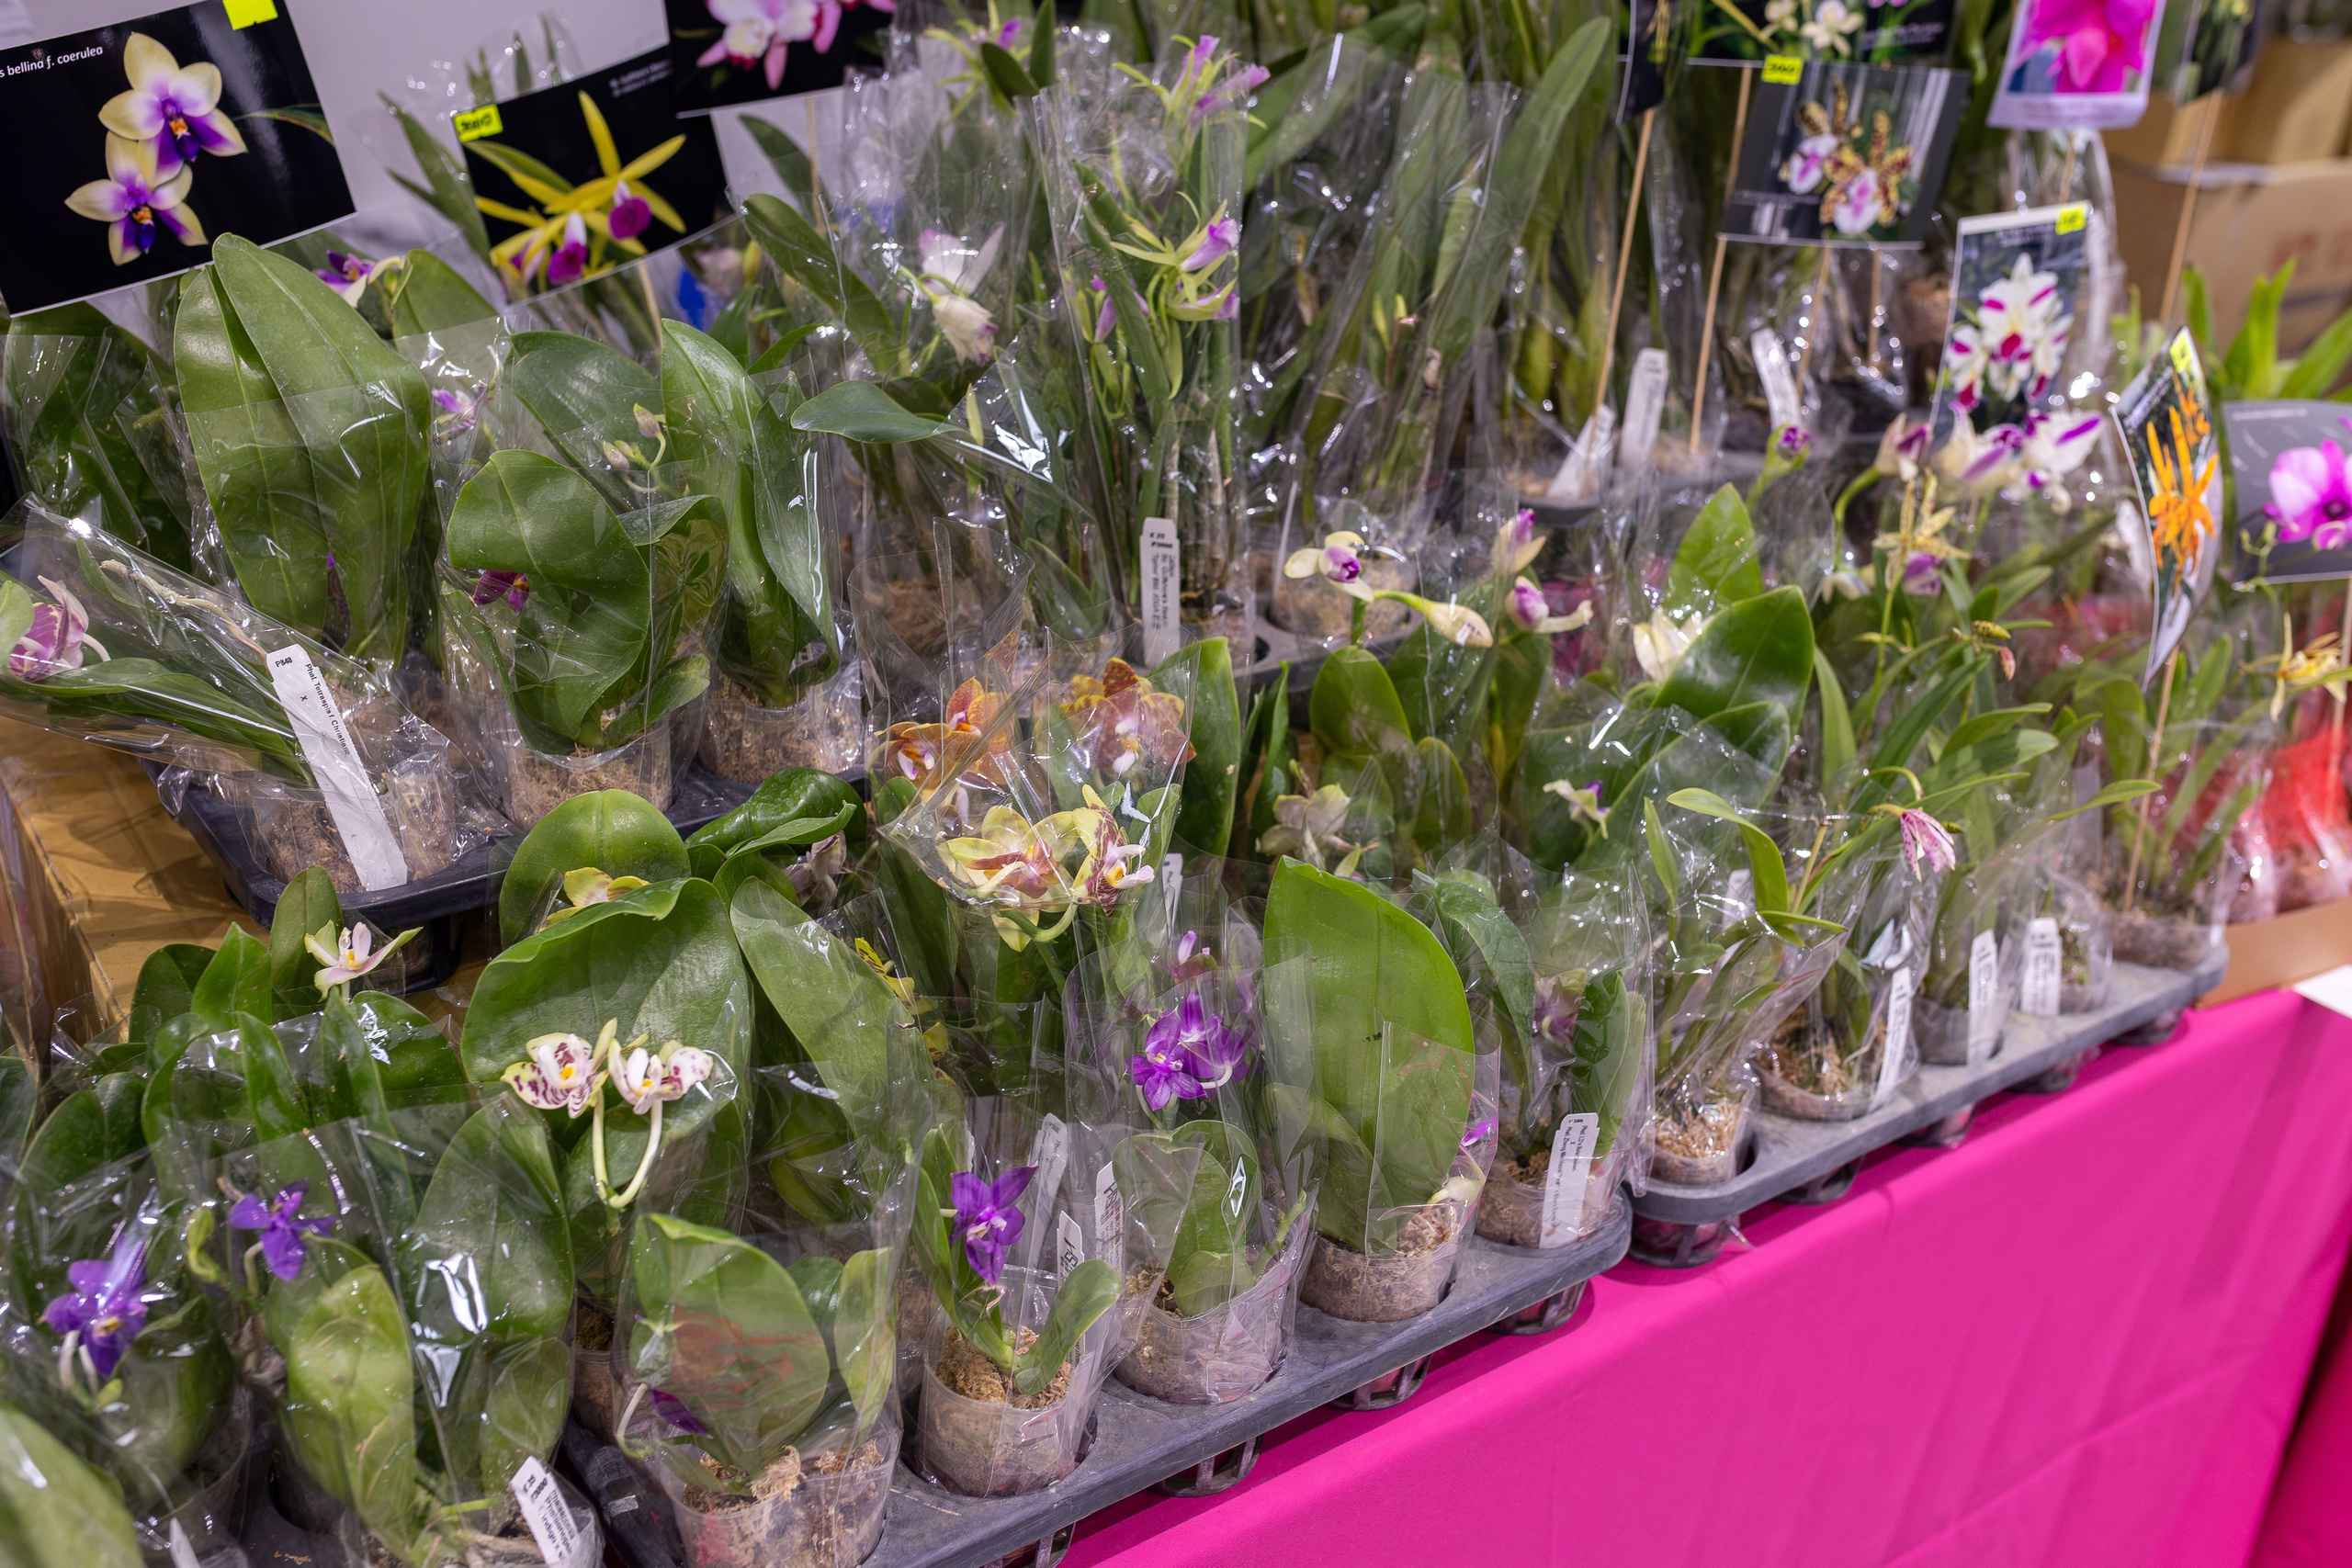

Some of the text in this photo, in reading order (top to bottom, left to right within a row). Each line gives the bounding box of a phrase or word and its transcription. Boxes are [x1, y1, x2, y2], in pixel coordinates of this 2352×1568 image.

[6, 60, 44, 76] bellina
[46, 55, 55, 70] f.
[57, 46, 104, 64] coerulea
